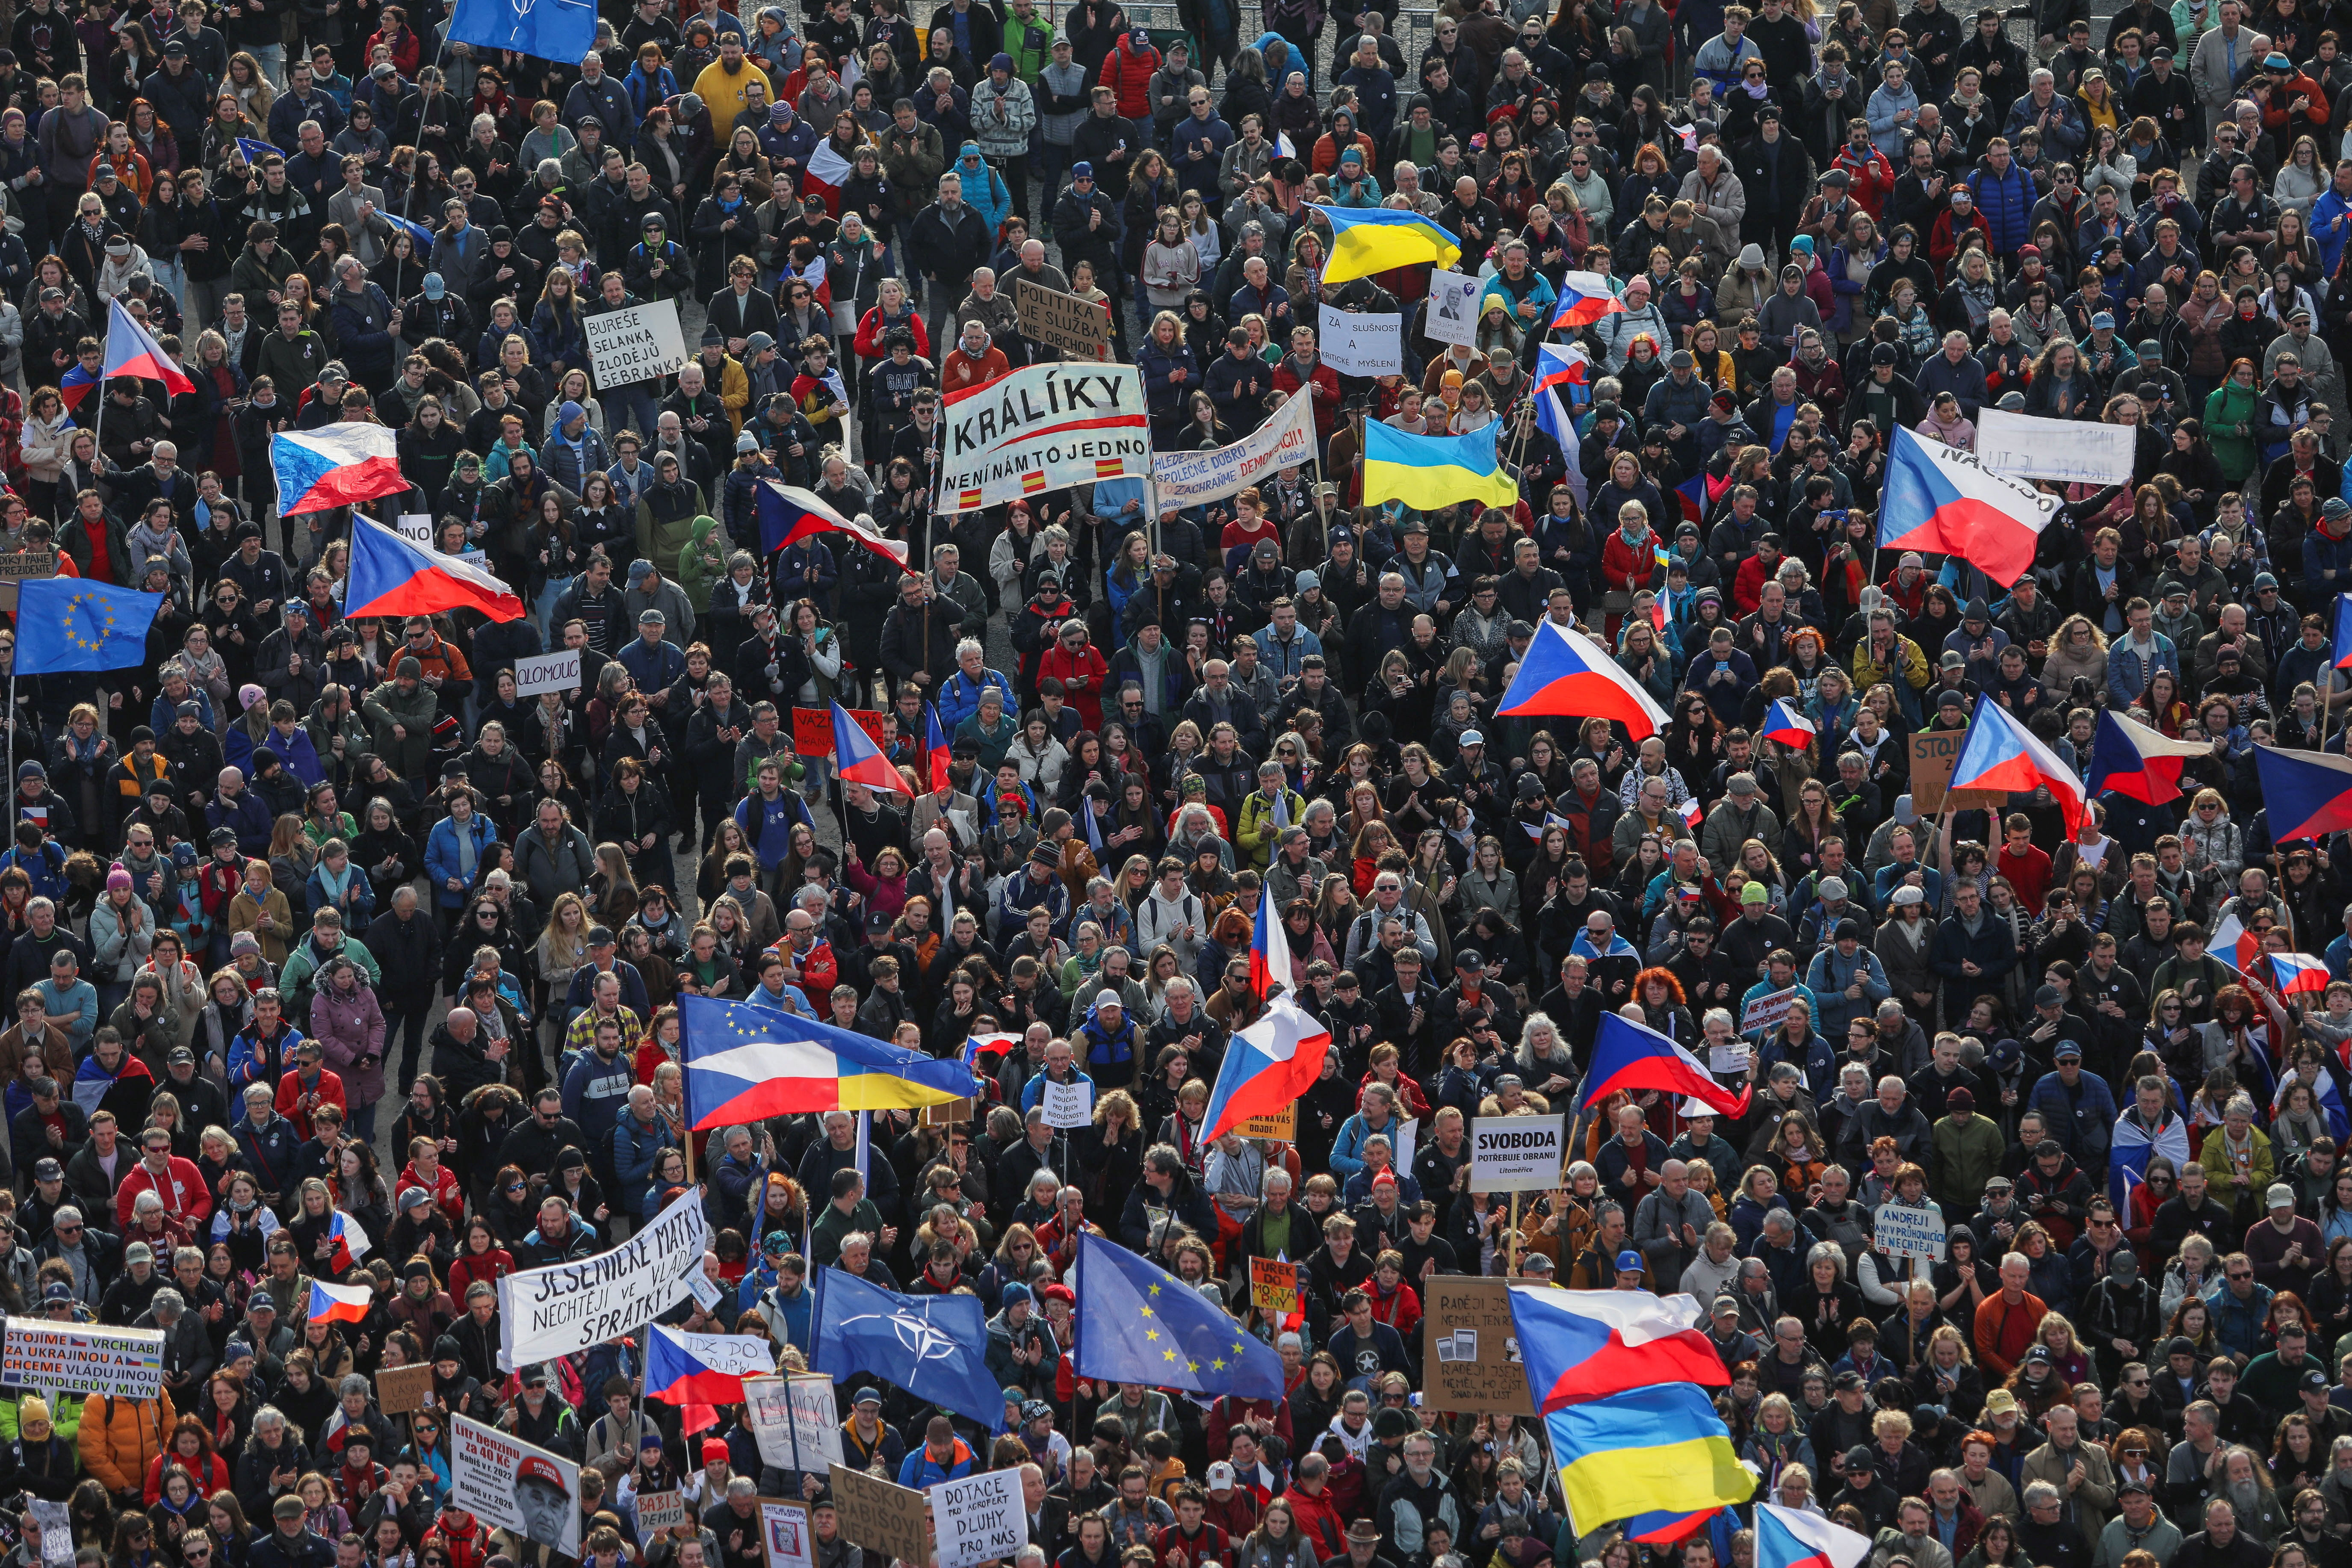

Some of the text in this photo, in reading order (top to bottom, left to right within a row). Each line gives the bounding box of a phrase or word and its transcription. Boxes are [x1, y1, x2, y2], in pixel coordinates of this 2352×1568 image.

[1020, 283, 1094, 320] POLITIKA
[1021, 304, 1038, 320] JE
[588, 311, 640, 336] BUREŠE
[1023, 322, 1040, 338] NE
[1329, 316, 1341, 329] ZA
[1352, 323, 1399, 332] SLUŠNOST
[1430, 318, 1452, 329] STOJÍM
[594, 329, 654, 353] SELANKA
[1348, 340, 1357, 349] A
[597, 342, 659, 372] ZLODĚJŮ
[1321, 351, 1396, 367] KRITICKÉ MYŠLENÍ
[602, 356, 683, 387] SEBRANKA
[886, 372, 919, 390] GANT
[954, 370, 1122, 456] KRÁLÍKY
[1032, 446, 1060, 467] TO
[1067, 440, 1145, 460] JEDNO
[1156, 444, 1247, 483] SPOLEČNÉ DOBRO
[1173, 470, 1237, 495] ZACHRAŇME
[398, 526, 430, 541] RNO
[0, 555, 50, 565] DÍKY PANE
[0, 564, 52, 576] PREZIDENTE
[517, 659, 578, 685] OLOMOUC
[796, 712, 833, 728] VÁŽN
[1945, 759, 1953, 771] Z
[1748, 1002, 1761, 1015] NE
[1052, 1094, 1078, 1103] VNOUČATA,
[1047, 1111, 1084, 1119] BUDOUCNOST!
[1063, 1104, 1078, 1113] JEJICH
[1276, 1114, 1290, 1124] VÁS
[1478, 1131, 1557, 1150] SVOBODA
[1478, 1152, 1556, 1162] POTŘEBUJE OBRANU
[654, 1201, 703, 1259] MATKY
[1875, 1223, 1888, 1234] ANI
[1890, 1226, 1895, 1235] V
[1876, 1234, 1934, 1253] TĚ NECHTĚJÍ
[1264, 1273, 1281, 1286] DO
[532, 1283, 612, 1332] NECHTĚJÍ
[621, 1282, 636, 1301] VE
[1261, 1294, 1288, 1308] RNY
[1441, 1294, 1484, 1311] RADĚJI
[579, 1279, 674, 1346] SPRATKY!
[1441, 1313, 1500, 1327] NEMĚL TEN
[6, 1329, 160, 1355] STOJÍME VRCHLABÍ
[687, 1337, 718, 1354] IDŽ
[726, 1341, 758, 1358] DO
[5, 1346, 124, 1366] ZA UKRAJINOU A
[3, 1359, 160, 1383] CHCEME VLÁDU JINOU.
[420, 1370, 428, 1378] A
[1441, 1362, 1521, 1378] RADĚJI JSEM
[22, 1371, 156, 1397] ŠPINDLERŮV MLÝN
[1443, 1376, 1477, 1389] NEMĚL
[1483, 1378, 1496, 1388] HO
[1451, 1390, 1512, 1400] SNAD ANI LIST
[455, 1423, 520, 1460] Litr benzínu
[465, 1441, 477, 1455] za
[480, 1447, 494, 1462] 40
[459, 1452, 481, 1468] Babiš
[493, 1466, 512, 1482] 2022
[467, 1474, 494, 1489] zastropovat
[492, 1475, 501, 1484] DPH
[460, 1481, 481, 1497] Babiš
[494, 1495, 513, 1511] 2026
[843, 1470, 906, 1512] ČESKO
[945, 1477, 1005, 1506] DOTACE
[458, 1498, 490, 1517] zastropování
[637, 1491, 681, 1513] BABIŠ
[947, 1495, 1010, 1518] PRO AGROFERT
[641, 1509, 682, 1526] DEMISI
[835, 1494, 921, 1539] BABIŠOVI
[838, 1518, 922, 1565] NEPATŘÍ
[959, 1524, 1016, 1556] PRO NÁS
[990, 1549, 1004, 1558] VÁM
